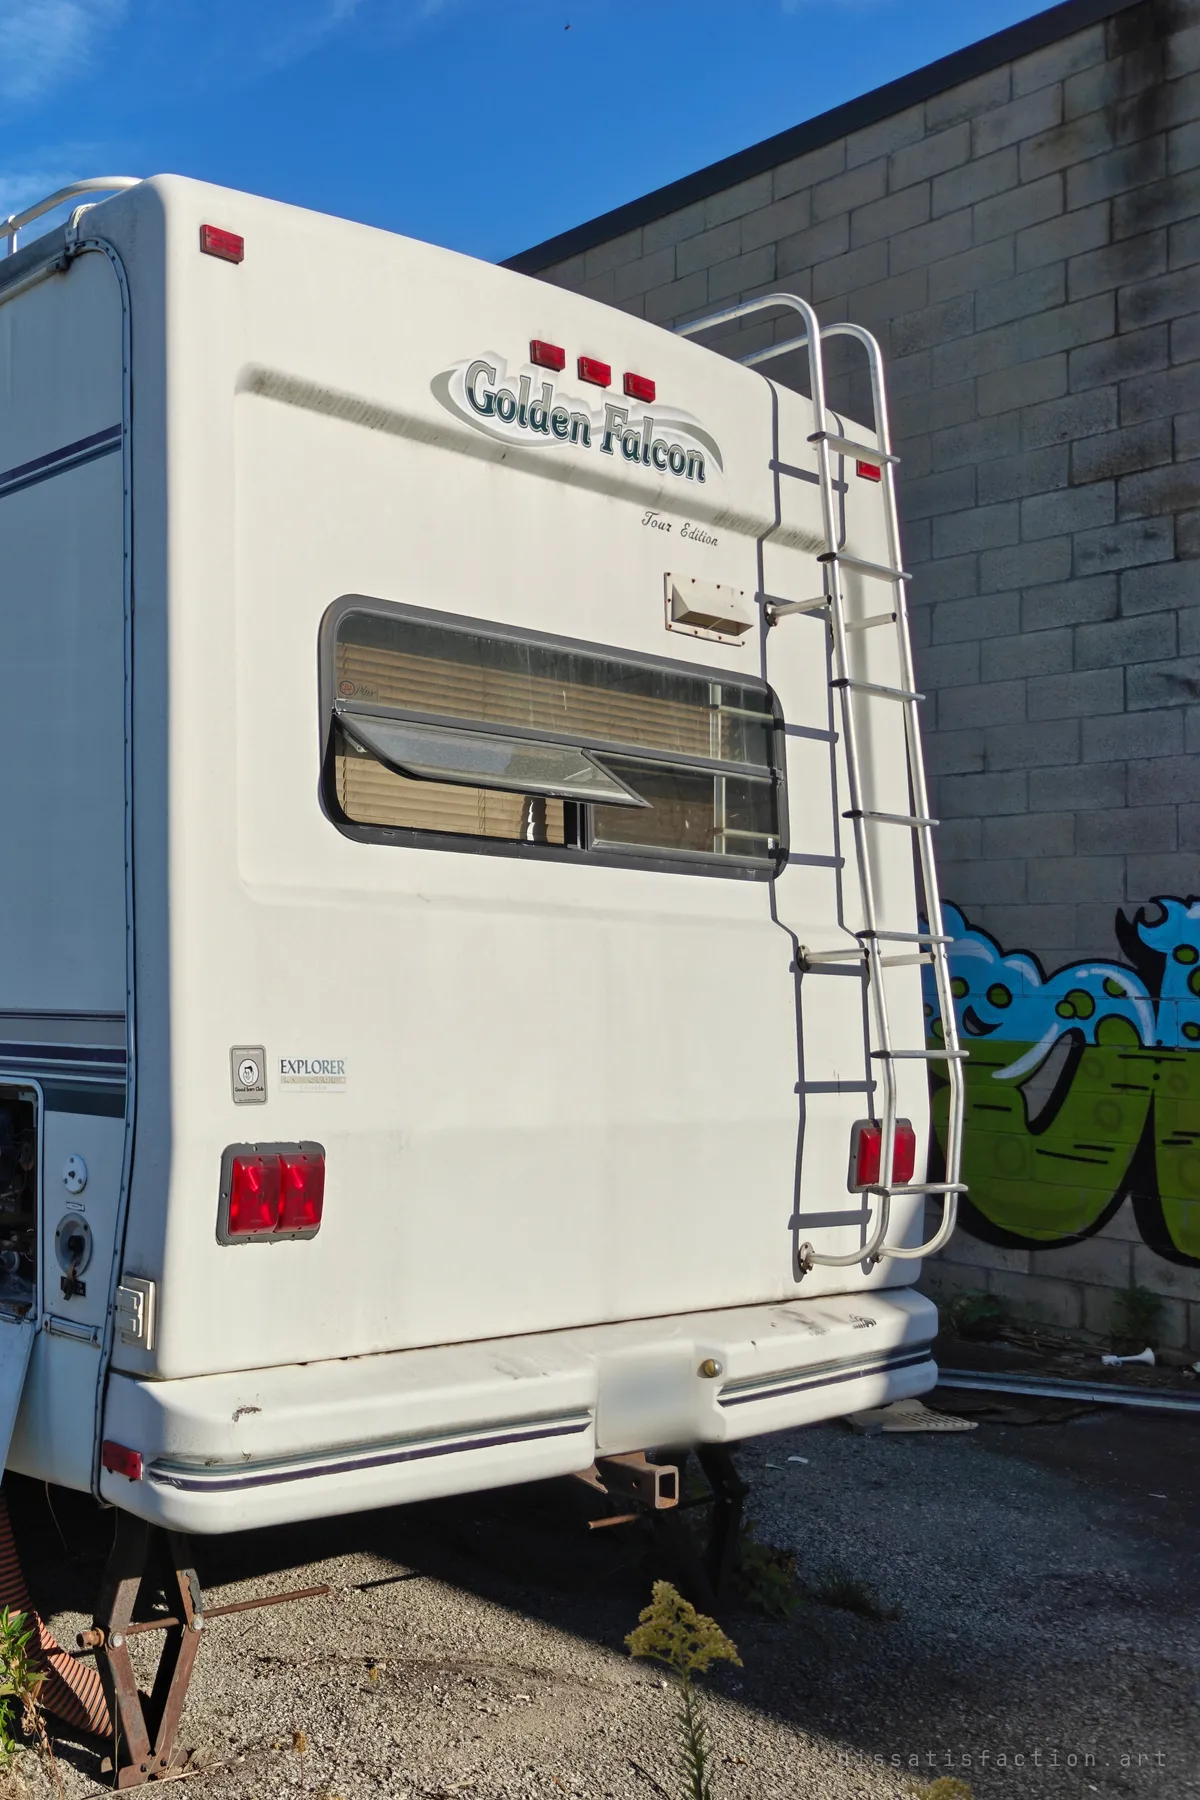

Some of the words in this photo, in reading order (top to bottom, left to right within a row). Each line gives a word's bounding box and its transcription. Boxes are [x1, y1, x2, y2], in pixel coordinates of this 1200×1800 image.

[464, 359, 592, 449] Golden
[600, 402, 706, 484] Falcon
[641, 511, 672, 534] Tour
[680, 522, 719, 547] Edition
[280, 1059, 345, 1075] EXPLORER
